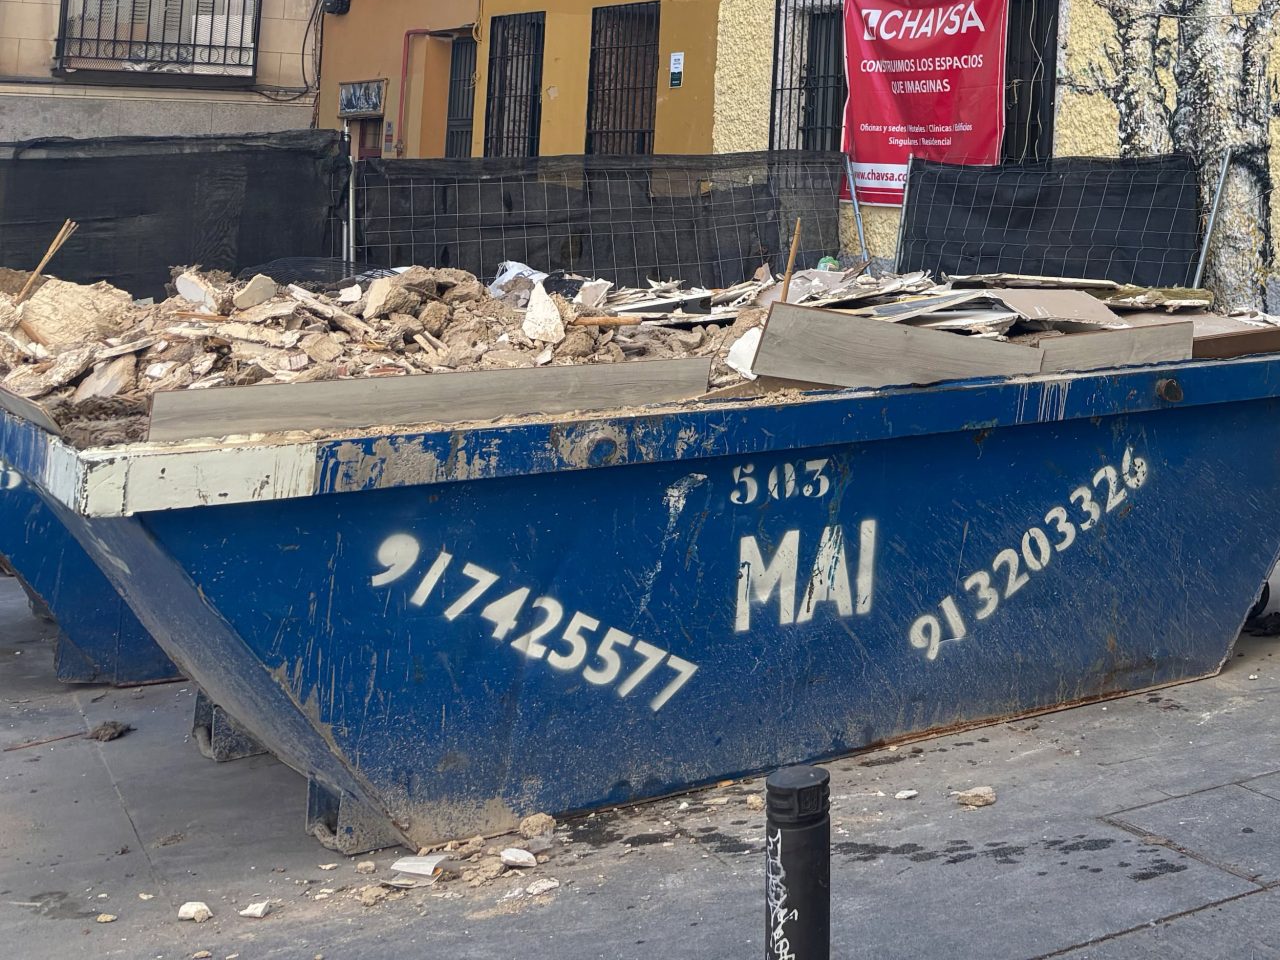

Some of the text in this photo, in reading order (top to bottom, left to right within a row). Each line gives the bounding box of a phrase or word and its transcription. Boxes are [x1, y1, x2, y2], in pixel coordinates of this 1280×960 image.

[880, 1, 986, 40] CHAVSA
[860, 54, 984, 73] CONSTRUIMOS LOS ESPACIOS
[891, 78, 951, 94] QUE IMAGINAS
[860, 123, 882, 133] Oficinas
[888, 123, 907, 133] sedes
[909, 124, 926, 133] Hoteles
[888, 136, 952, 147] Singulares Residencial
[730, 458, 832, 506] 503
[909, 445, 1148, 661] 913203326
[733, 519, 878, 633] MAI
[371, 533, 699, 713] 917425577
